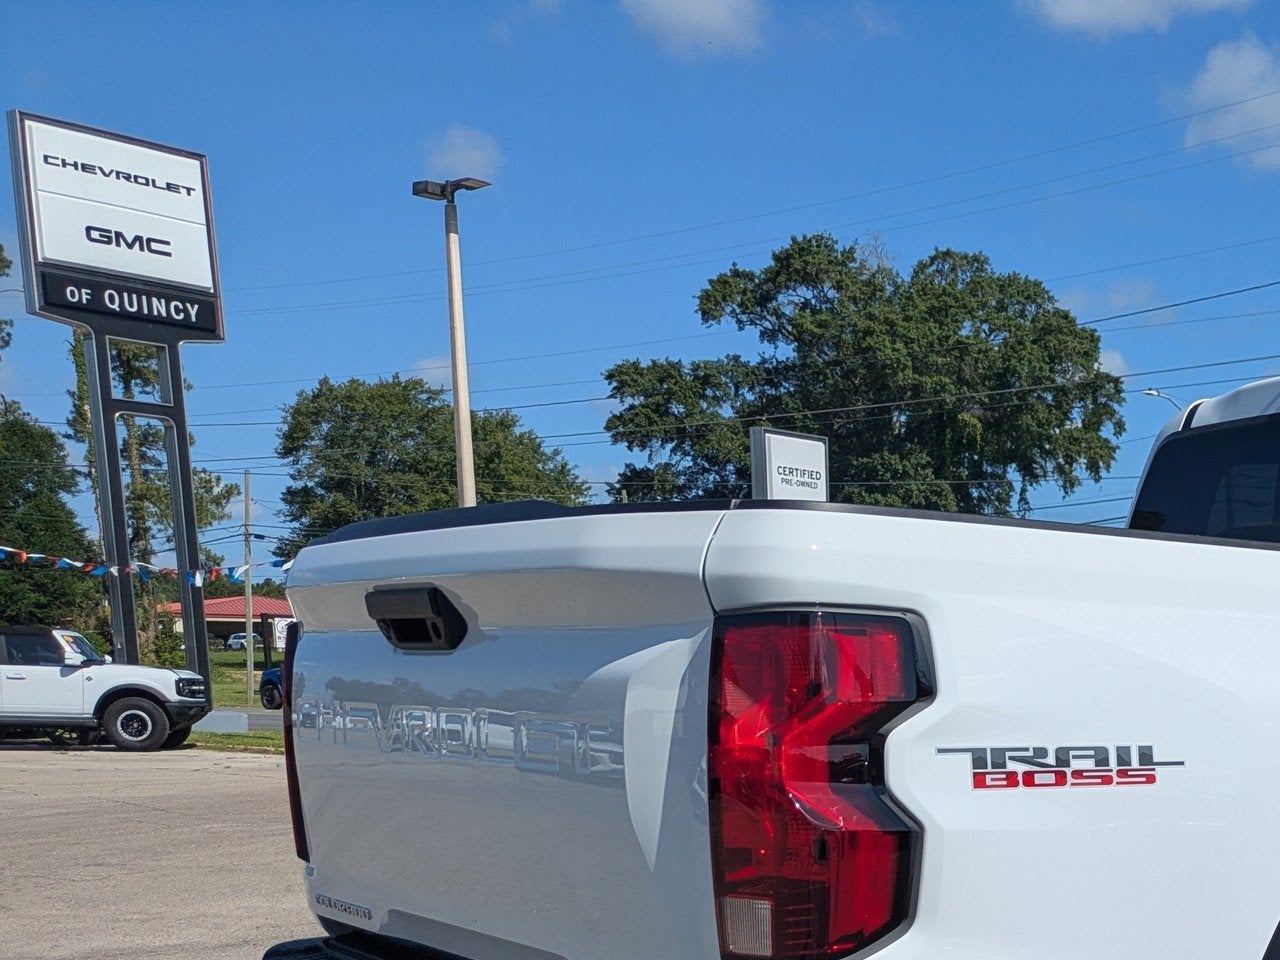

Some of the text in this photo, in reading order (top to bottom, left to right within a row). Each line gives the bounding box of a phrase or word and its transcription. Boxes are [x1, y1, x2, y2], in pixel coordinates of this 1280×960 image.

[43, 154, 196, 197] CHEVROLET
[85, 225, 173, 257] GMC
[66, 286, 200, 322] OF QUINCY
[777, 465, 822, 481] CERTIFIED
[781, 477, 819, 490] PRE-OWNED
[935, 744, 1186, 770] TRAIL
[972, 768, 1157, 790] BOSS
